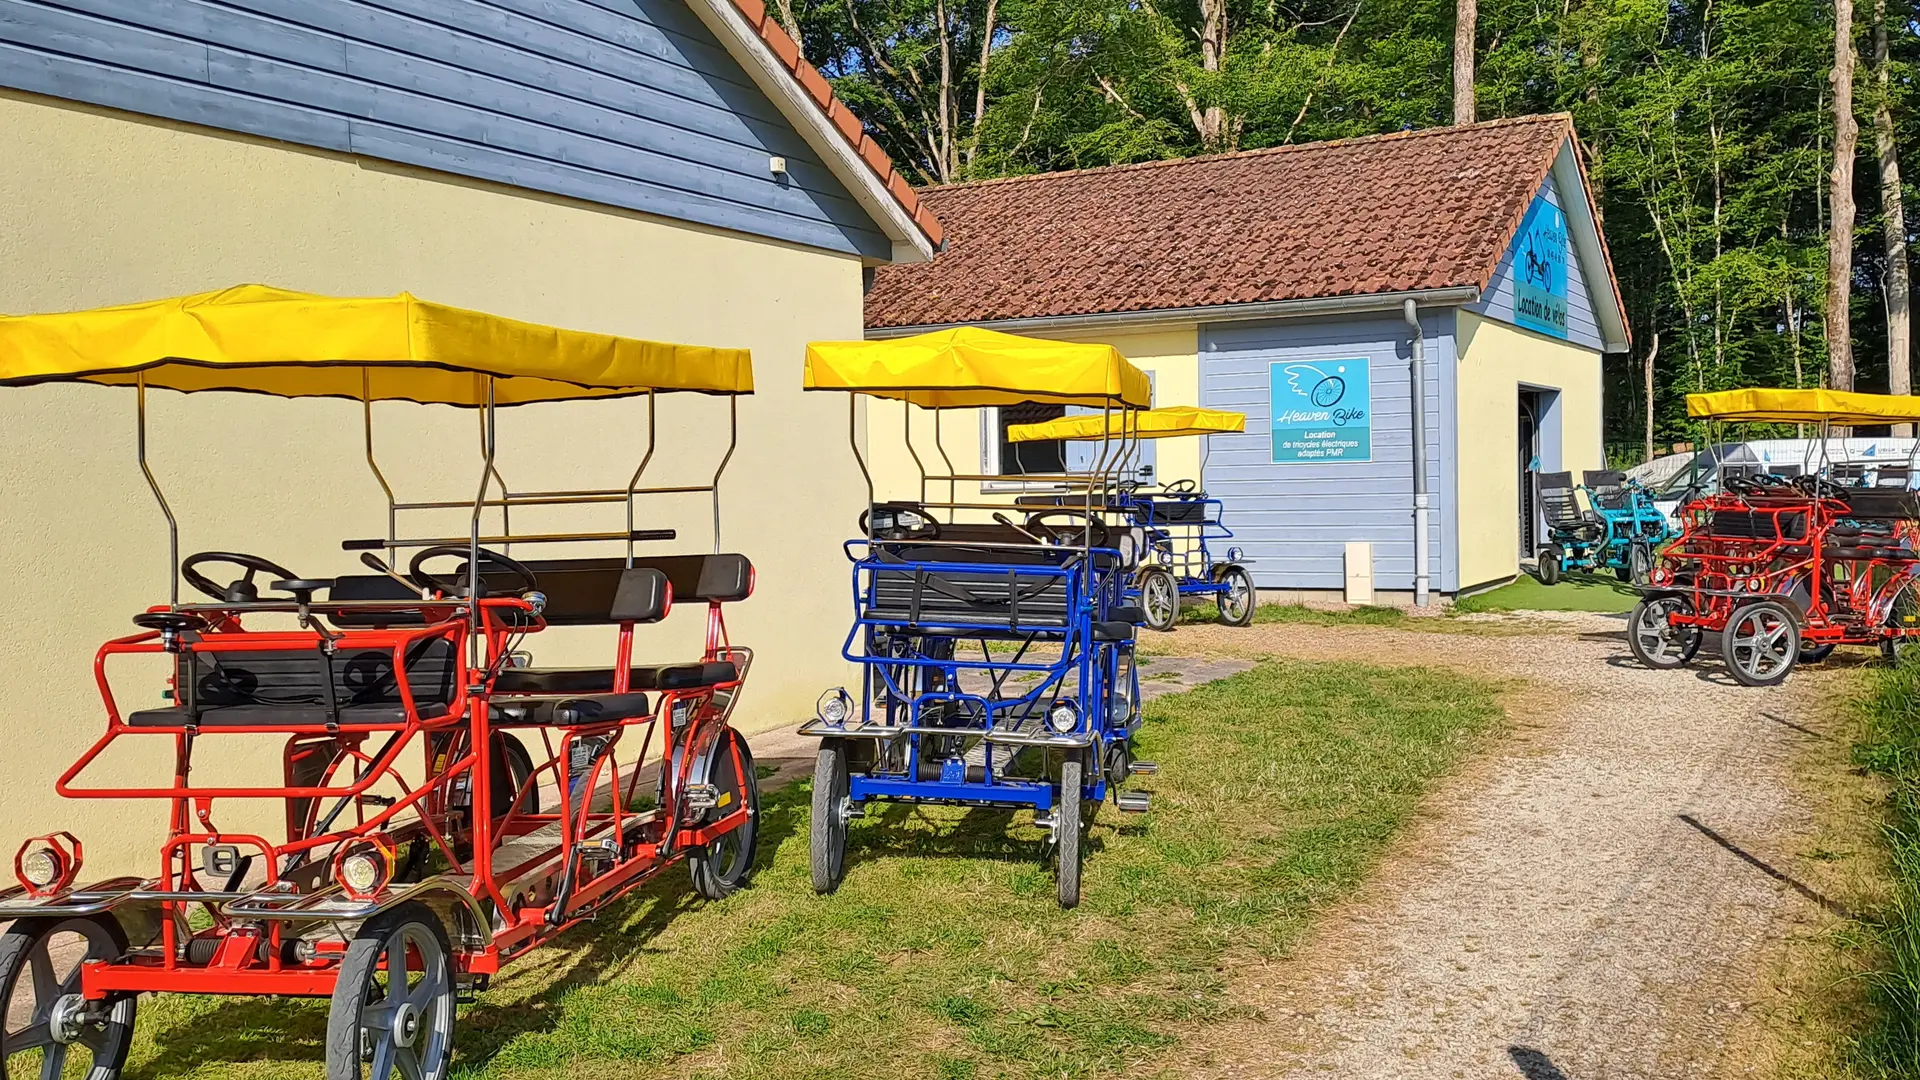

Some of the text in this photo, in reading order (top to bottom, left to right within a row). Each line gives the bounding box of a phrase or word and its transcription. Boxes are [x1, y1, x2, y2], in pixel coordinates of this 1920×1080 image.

[1518, 288, 1565, 326] Location de vélos
[1277, 407, 1365, 426] Heaven Bike
[1304, 431, 1336, 439] Location
[1292, 440, 1320, 449] tricycles
[1321, 439, 1359, 449] électriques
[1298, 448, 1344, 458] adaptés PMR
